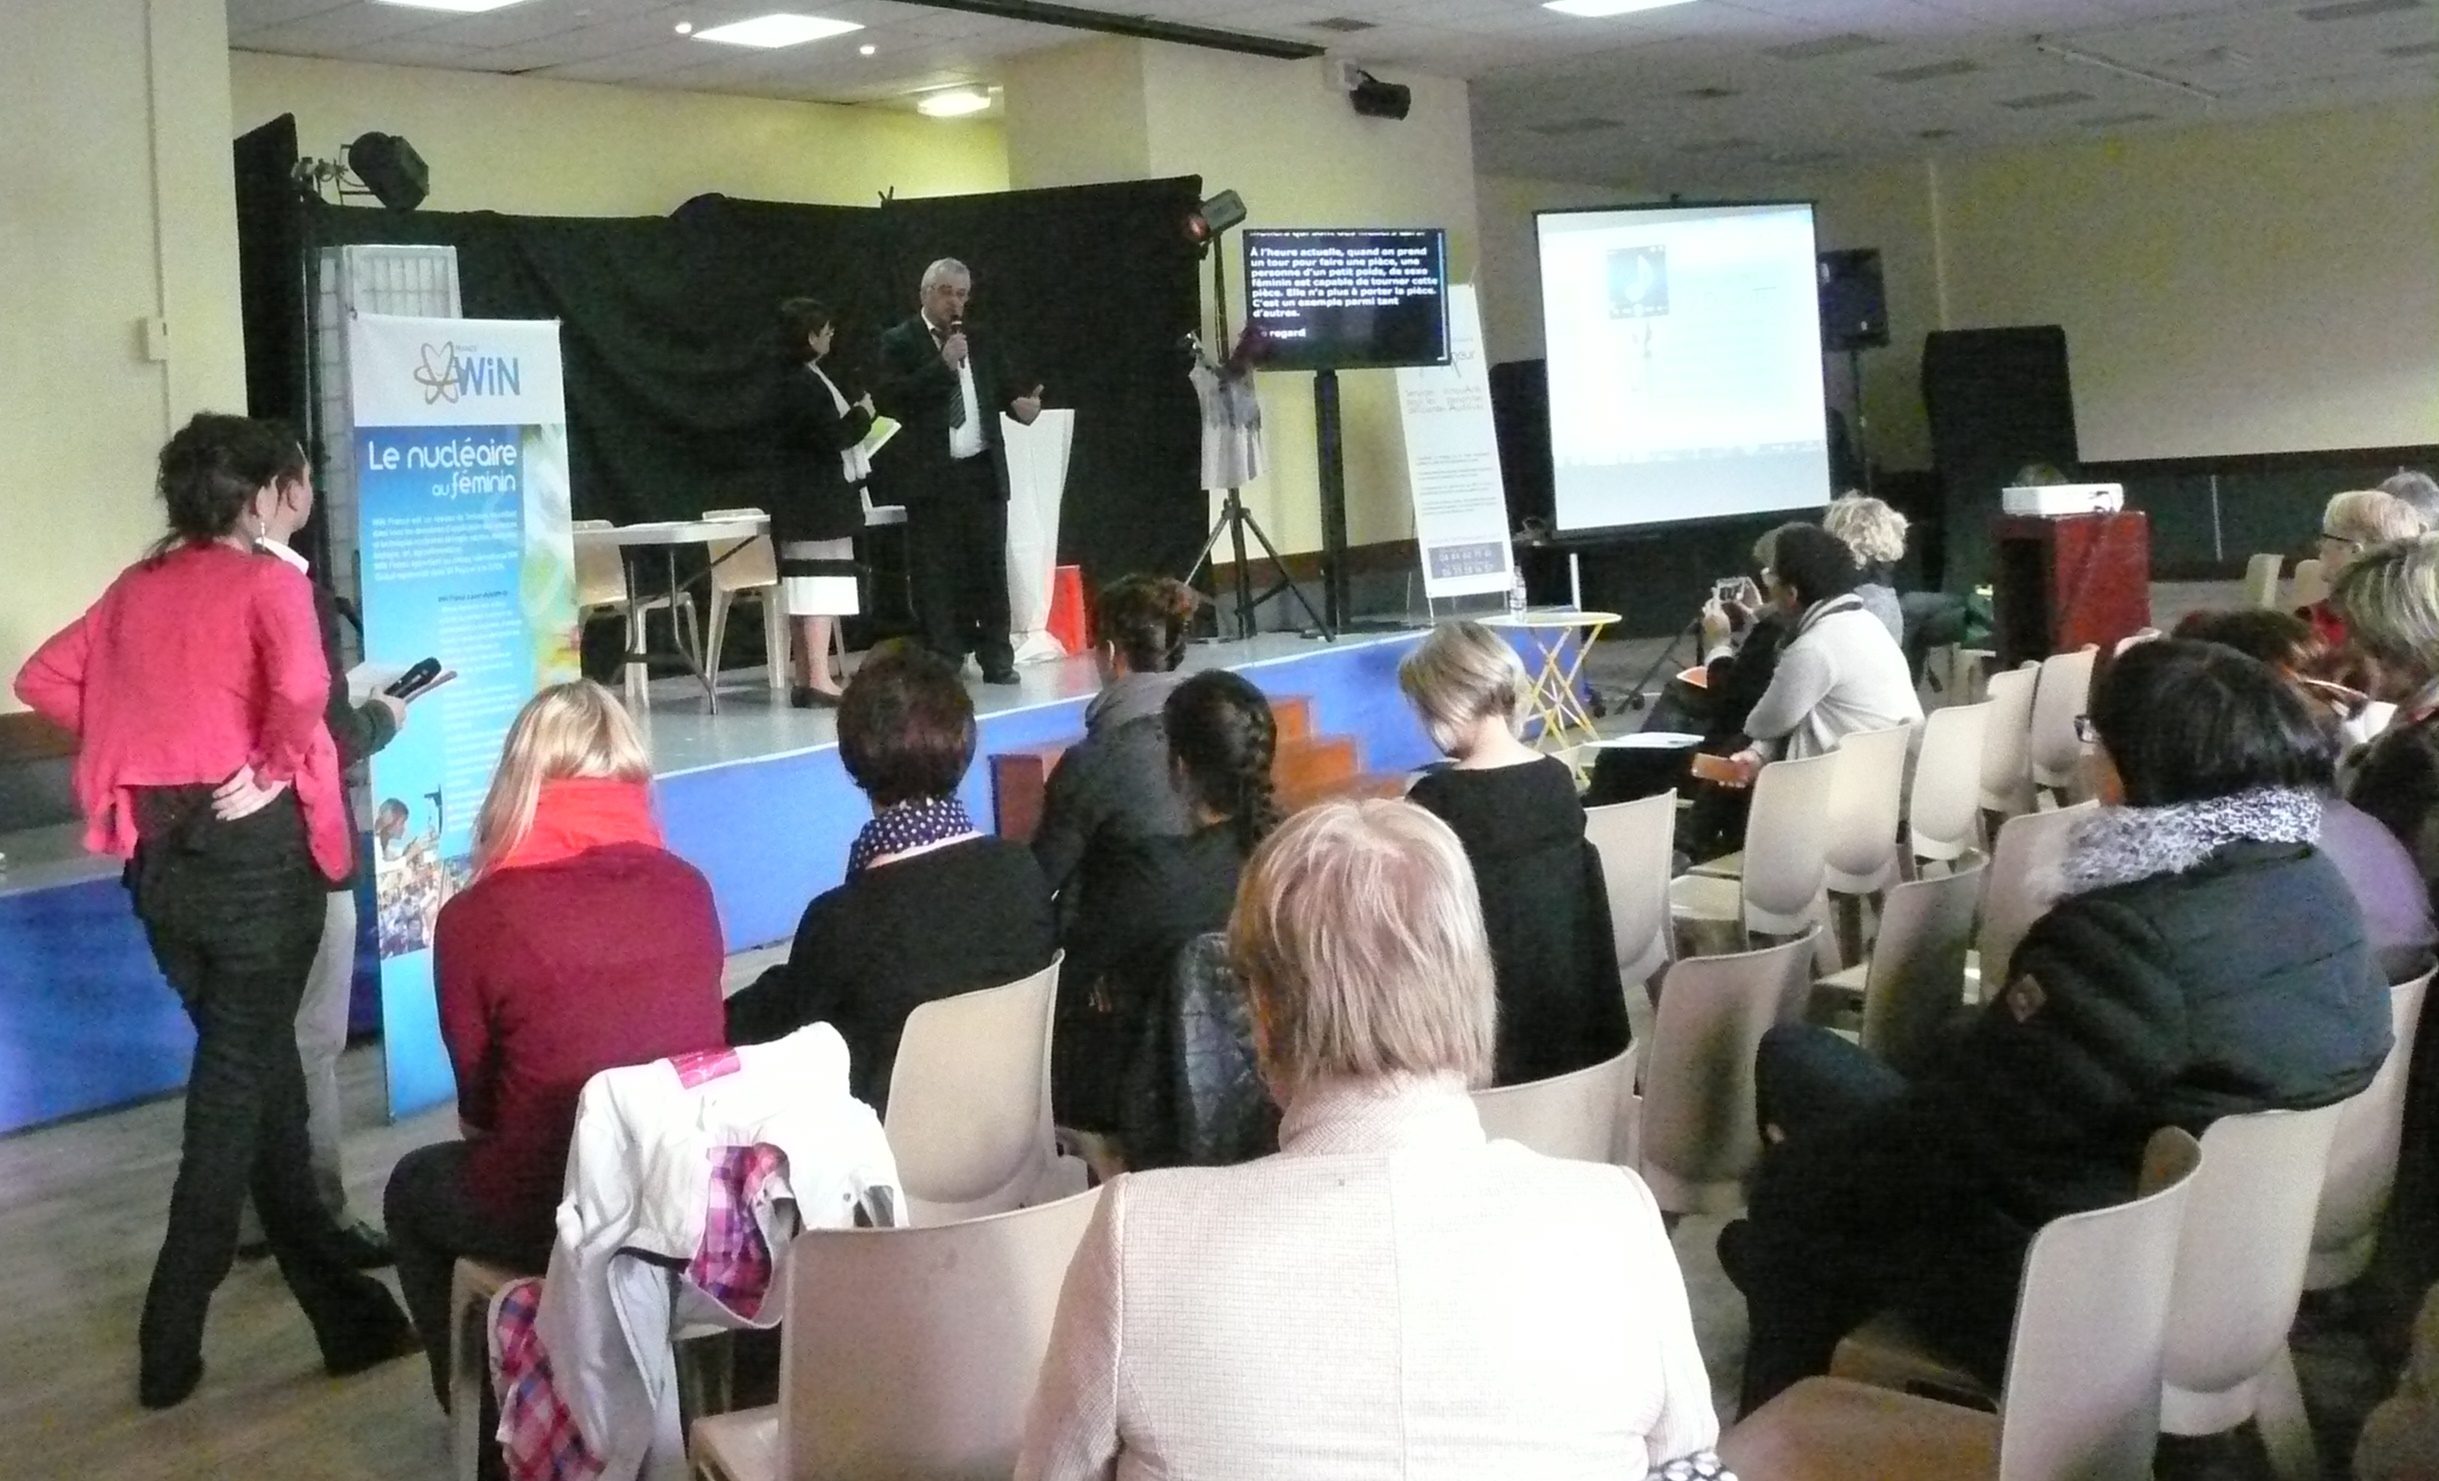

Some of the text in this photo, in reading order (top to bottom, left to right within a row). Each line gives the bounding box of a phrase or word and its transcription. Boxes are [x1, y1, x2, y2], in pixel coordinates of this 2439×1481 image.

[1260, 248, 1298, 257] l'heure
[1300, 248, 1344, 257] actuelle,
[1347, 247, 1380, 257] quand
[1381, 248, 1395, 256] on
[1397, 247, 1427, 257] prend
[1251, 259, 1265, 267] un
[1267, 258, 1290, 267] tour
[1292, 259, 1317, 268] pour
[1319, 257, 1344, 267] faire
[1368, 257, 1398, 267] pièce,
[1400, 258, 1420, 266] une
[1251, 267, 1428, 278] personne d'un petit poids, de sexe
[1252, 277, 1438, 288] féminin est capable de tourner cette
[1252, 286, 1437, 298] pièce. Elle n'a plus à porter la pièce.
[1252, 299, 1279, 308] C'est
[1298, 297, 1343, 308] exemple
[1345, 297, 1375, 307] parmi
[1377, 297, 1400, 306] tant
[1252, 309, 1300, 318] d'autres.
[1269, 328, 1307, 339] regard
[368, 437, 517, 471] Le nucléaire
[432, 470, 516, 500] au féminin
